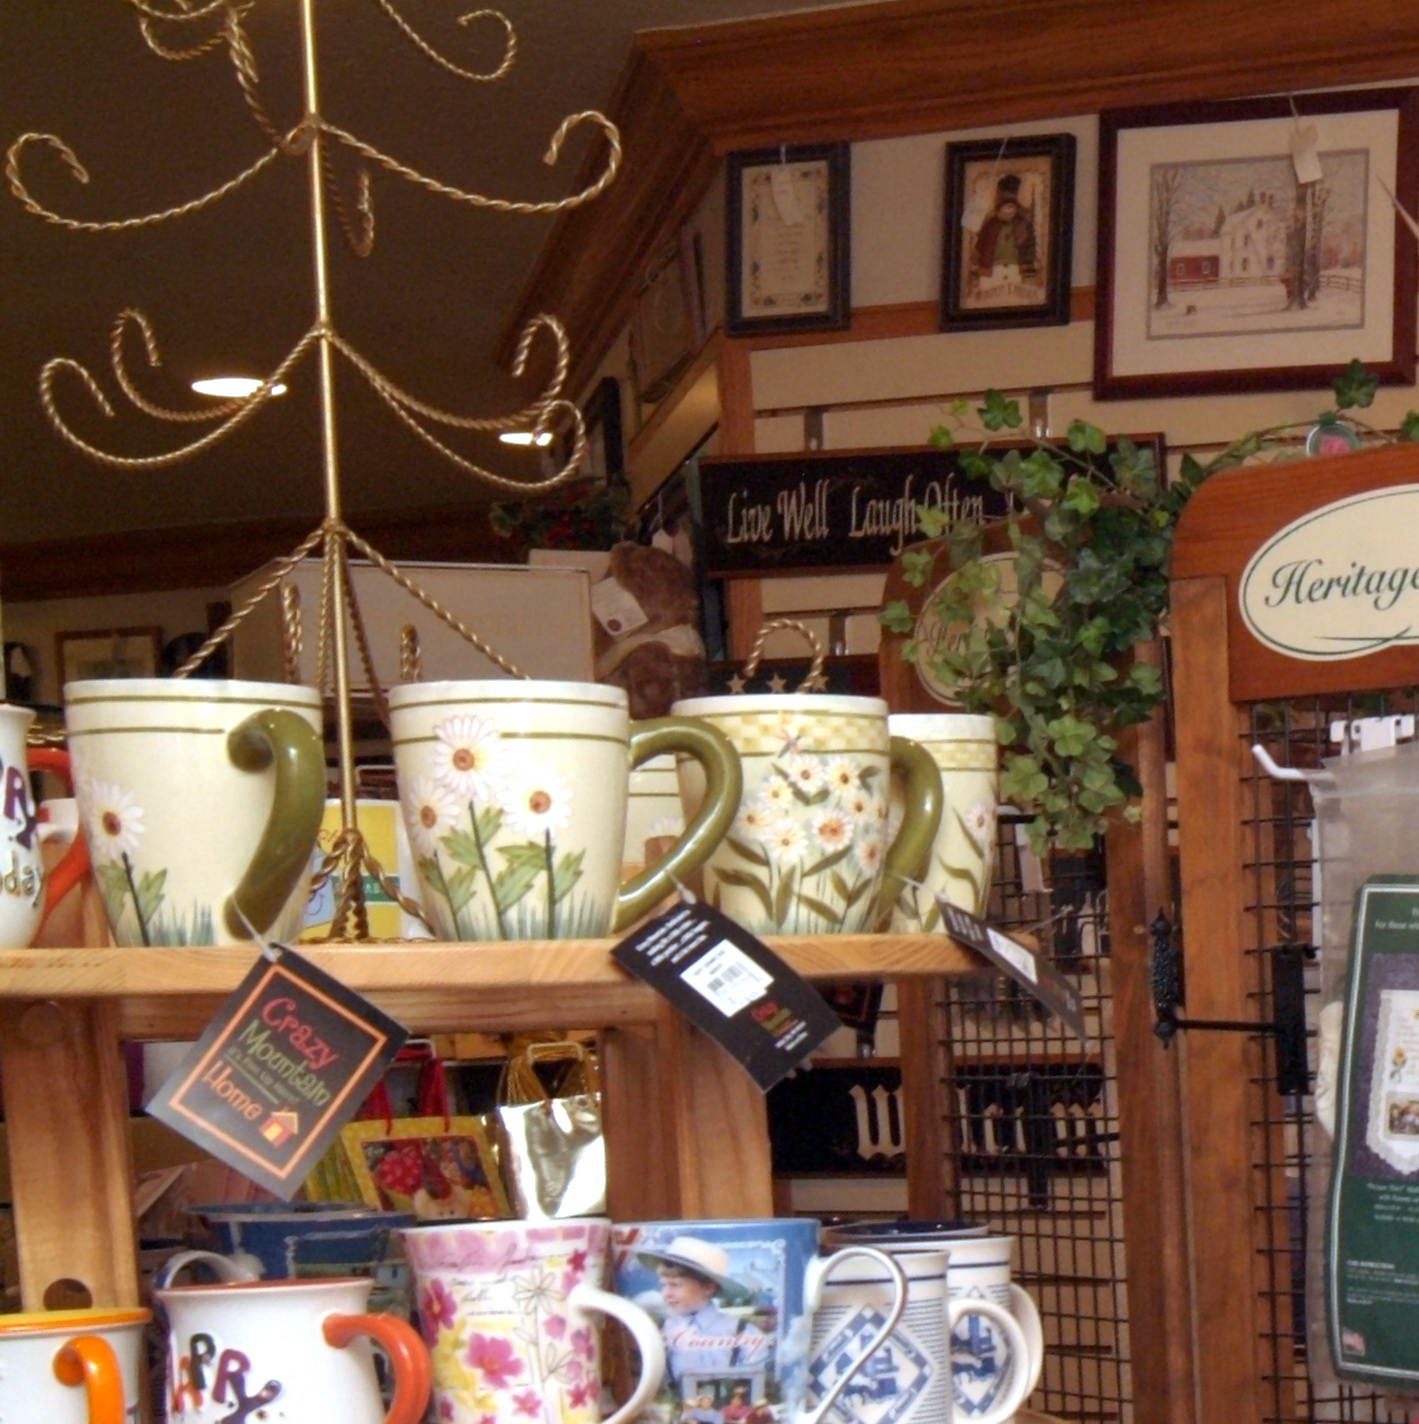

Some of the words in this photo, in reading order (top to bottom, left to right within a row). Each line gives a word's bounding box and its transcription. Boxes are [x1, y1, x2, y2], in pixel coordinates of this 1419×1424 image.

[725, 488, 773, 545] Live
[775, 481, 830, 541] Well
[849, 478, 916, 555] Laugh
[236, 1016, 332, 1108] Mountain
[260, 997, 341, 1072] Crazy
[202, 1059, 264, 1121] Home
[665, 1328, 768, 1365] Country
